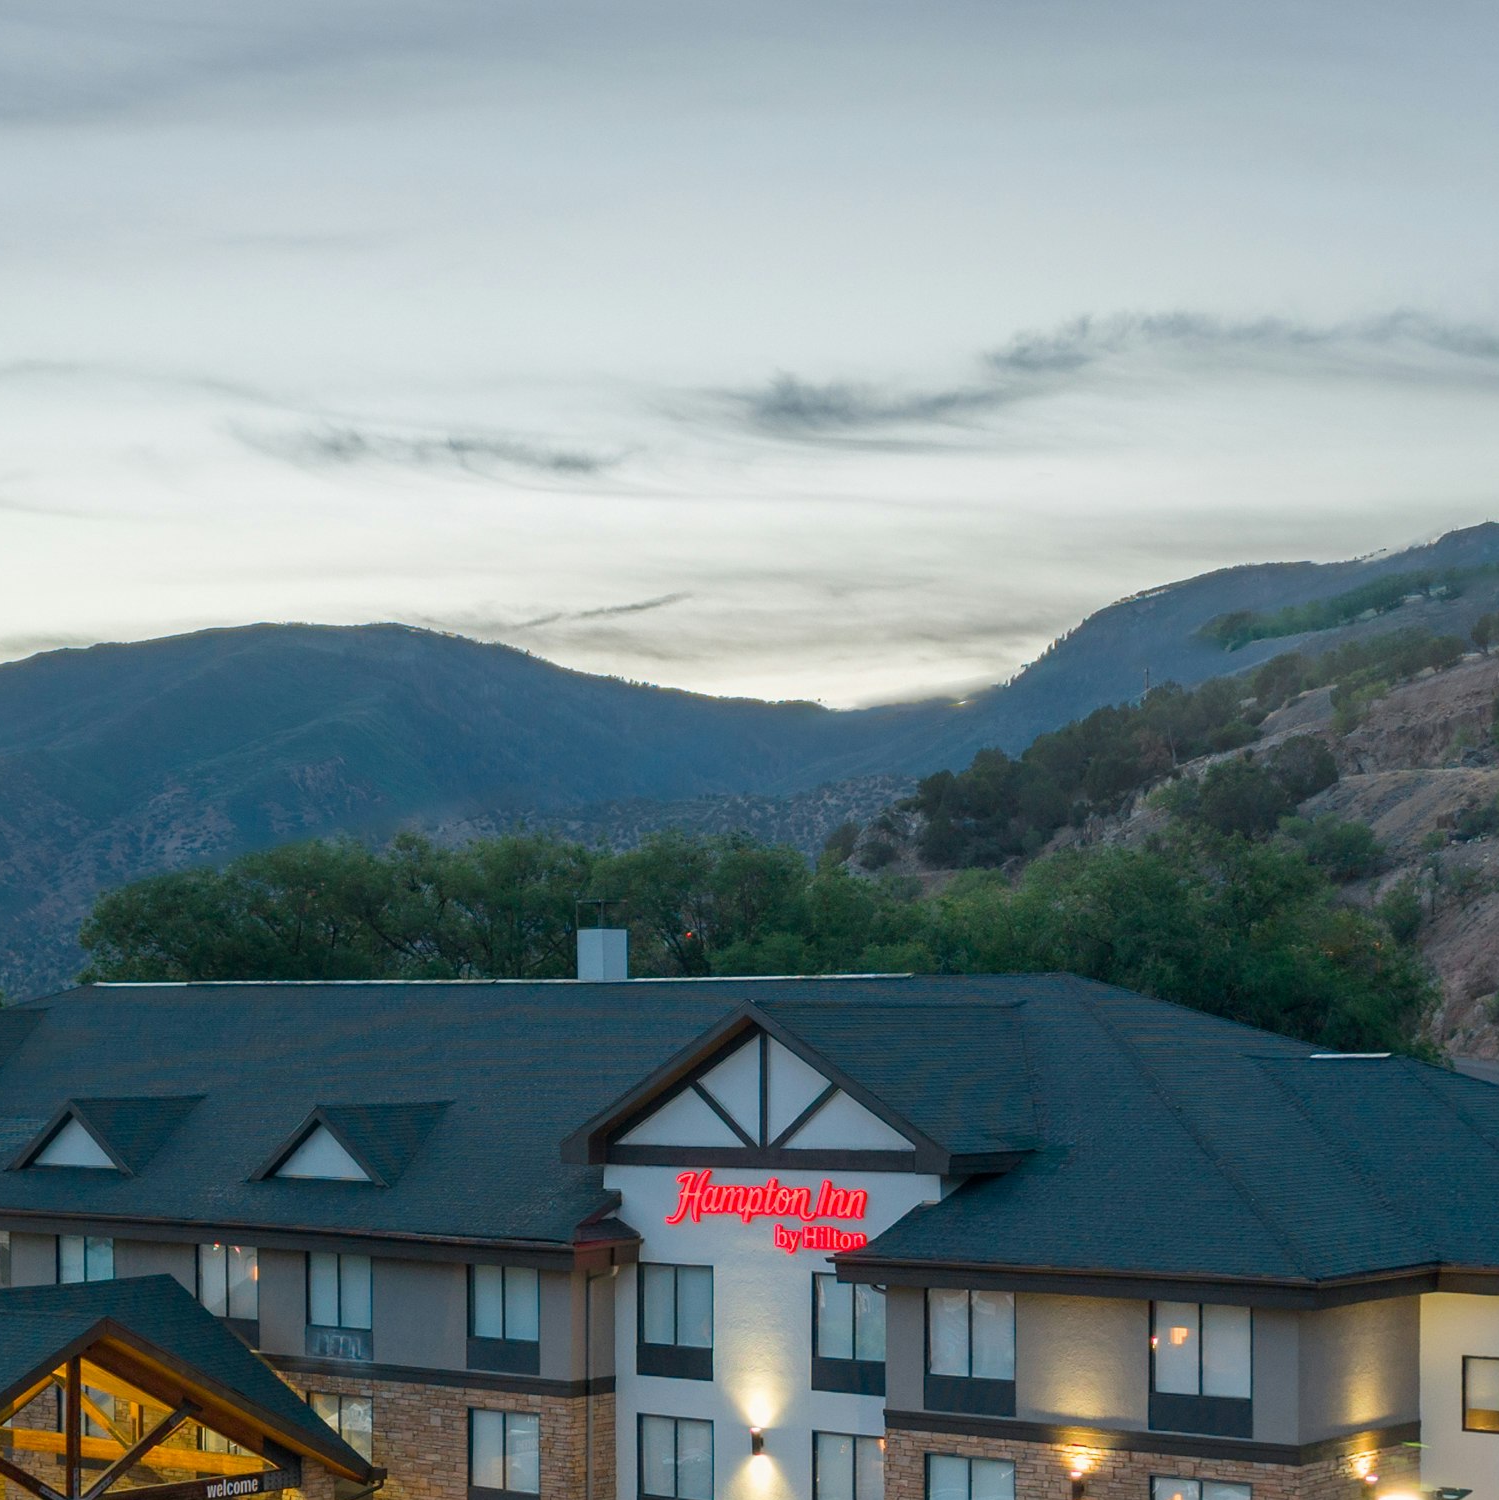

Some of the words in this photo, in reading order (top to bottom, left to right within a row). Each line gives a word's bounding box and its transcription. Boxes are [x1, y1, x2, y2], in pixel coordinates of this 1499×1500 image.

[665, 1170, 815, 1224] Hampton
[815, 1179, 868, 1219] Inn
[774, 1223, 801, 1254] by
[802, 1225, 867, 1251] Hilton
[207, 1479, 258, 1498] welcome
